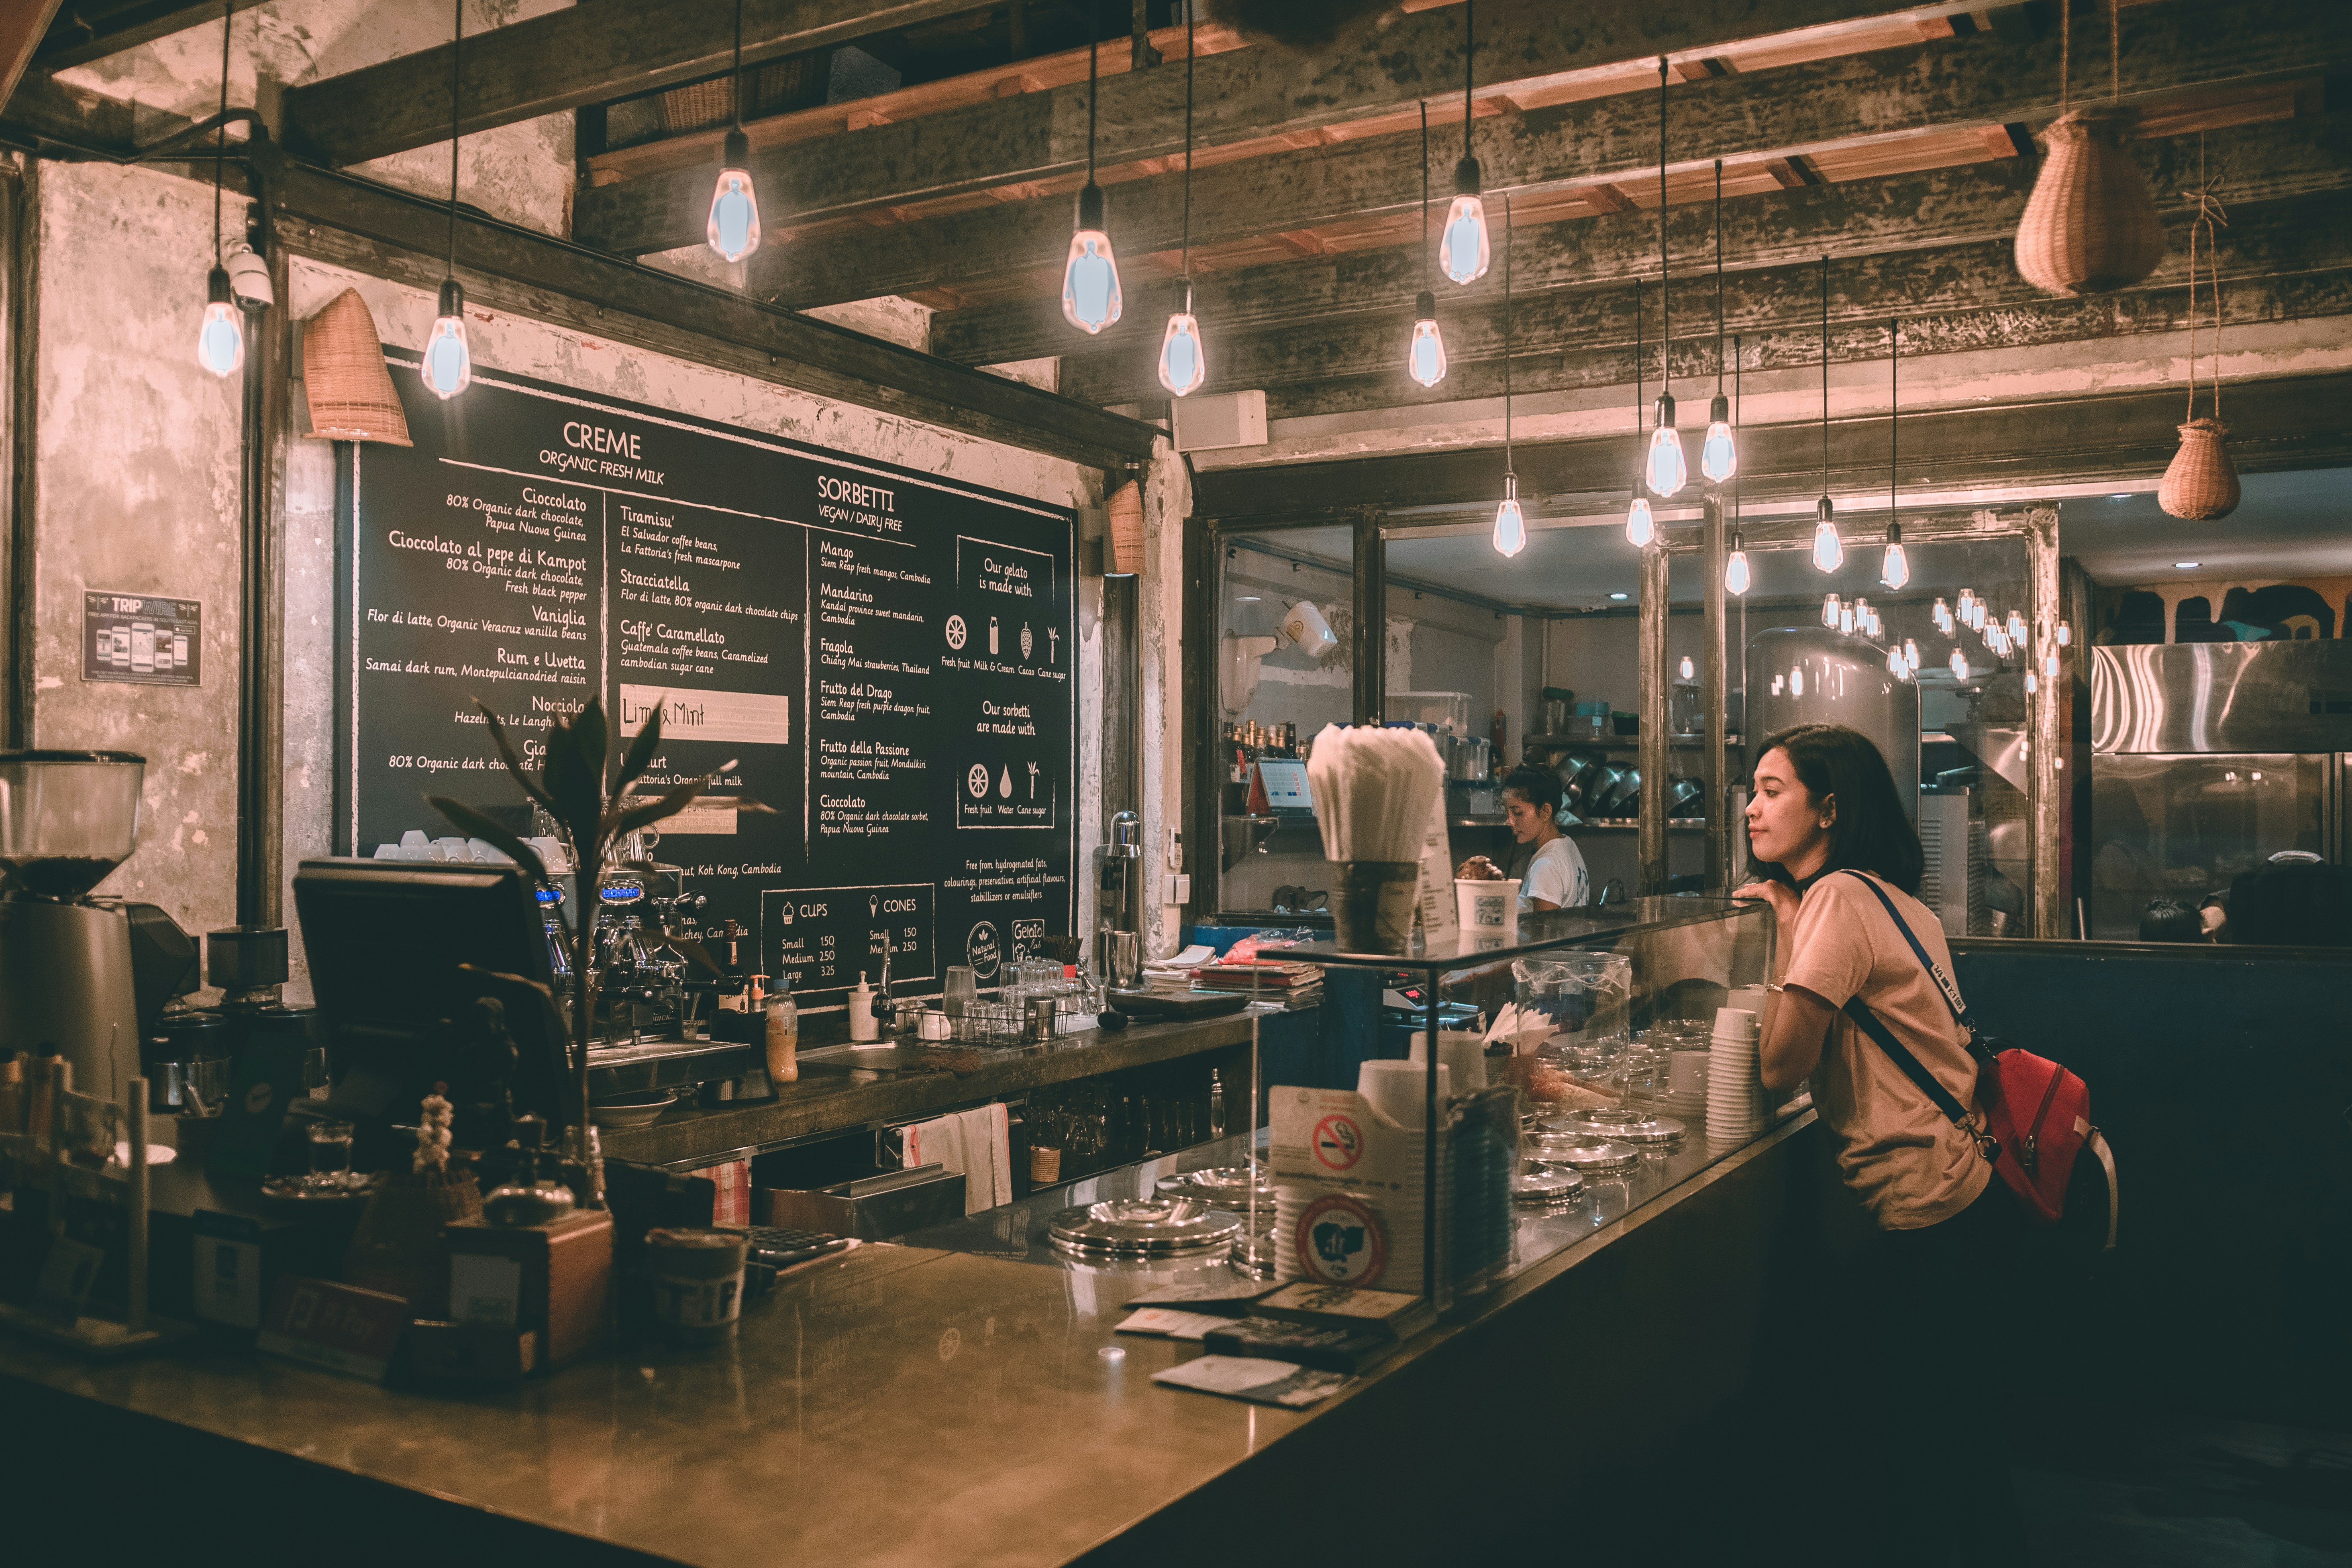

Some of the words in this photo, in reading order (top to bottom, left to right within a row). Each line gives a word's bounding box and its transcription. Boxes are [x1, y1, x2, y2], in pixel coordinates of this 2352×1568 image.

[564, 422, 641, 460] CREME
[540, 450, 597, 472] ORGANIC
[600, 461, 633, 479] FRESH
[636, 468, 664, 485] MILK
[523, 487, 586, 511] Cioccolato
[818, 476, 894, 512] SORBETTI
[447, 494, 469, 508] 80%
[473, 498, 512, 516] Organic
[516, 506, 537, 519] dark
[541, 510, 583, 527] chocolate,
[620, 506, 674, 528] Tiramisu'
[819, 504, 848, 523] VEGAN
[856, 512, 883, 532] DAIRY
[885, 518, 902, 531] FREE
[486, 516, 515, 533] Papua
[519, 521, 549, 536] Nuova
[554, 526, 586, 542] Guinea
[622, 526, 629, 536] El
[633, 528, 669, 542] Salvador
[672, 535, 692, 549] coffee
[695, 537, 717, 551] beans,
[389, 530, 461, 554] Cioccolato
[468, 541, 481, 557] al
[488, 548, 513, 567] pepe
[519, 548, 532, 563] di
[538, 550, 586, 575] Kampot
[621, 542, 631, 553] La
[635, 544, 671, 559] Fattoria's
[674, 550, 692, 564] fresh
[696, 557, 740, 571] mascarpone
[821, 541, 853, 563] Mango
[821, 557, 836, 568] Siem
[839, 560, 855, 575] Reap
[857, 563, 871, 575] fresh
[873, 569, 898, 581] mangos,
[900, 571, 930, 584] Cambodia
[985, 558, 1002, 573] Our
[1004, 563, 1028, 579] gelato
[621, 569, 689, 591] Stracciatella
[979, 575, 986, 589] is
[989, 579, 1012, 594] made
[1015, 582, 1032, 597] with
[506, 581, 528, 593] Fresh
[532, 583, 556, 597] black
[560, 591, 587, 604] pepper
[821, 583, 873, 602] Mandarino
[621, 589, 637, 600] Flor
[640, 591, 648, 602] di
[652, 592, 671, 606] latte,
[675, 595, 692, 607] 80%
[695, 601, 722, 613] organic
[725, 602, 742, 613] dark
[745, 605, 778, 618] chocolate
[781, 609, 798, 624] chips
[821, 599, 846, 611] Kandal
[848, 605, 873, 616] province
[875, 610, 890, 618] sweet
[893, 612, 924, 623] mandarin,
[368, 609, 389, 622] Flor
[392, 611, 403, 624] di
[408, 612, 432, 627] latte,
[437, 616, 478, 633] Organic
[482, 620, 521, 634] Veracruz
[525, 626, 557, 637] vanilla
[562, 629, 586, 640] beans
[532, 606, 586, 630] Vaniglia
[621, 620, 652, 642] Caffe'
[657, 624, 724, 644] Caramellato
[498, 648, 528, 665] Rum
[534, 656, 539, 666] e
[545, 652, 586, 669] Uvetta
[621, 639, 669, 655] Guatemala
[672, 645, 692, 660] coffee
[696, 646, 718, 660] beans,
[722, 650, 768, 663] Caramelized
[821, 638, 853, 658] Fragola
[366, 658, 401, 671] Samai
[406, 661, 430, 673] dark
[434, 667, 457, 676] rum,
[561, 673, 586, 684] raisin
[621, 657, 667, 669] cambodian
[671, 663, 693, 675] sugar
[821, 654, 846, 669] Chiang
[848, 657, 862, 667] Mai
[865, 661, 899, 672] strawberries,
[902, 663, 929, 674] Thailand
[942, 656, 956, 667] Fresh
[958, 658, 970, 671] fruit
[974, 660, 988, 670] Milk
[990, 662, 995, 671] &
[997, 663, 1014, 673] Cream
[1018, 665, 1034, 675] Cacao
[1038, 668, 1051, 677] Cane
[1053, 672, 1066, 682] sugar
[821, 680, 847, 695] Frutto
[851, 683, 863, 696] del
[867, 685, 892, 703] Drago
[662, 708, 671, 725] &
[674, 702, 704, 726] Mint
[983, 701, 1000, 715] Our
[1004, 703, 1030, 718] sorbetti
[977, 723, 989, 732] are
[993, 720, 1015, 734] made
[1018, 722, 1036, 735] with
[821, 739, 847, 752] Frutto
[851, 740, 872, 754] della
[876, 742, 909, 755] Passione
[821, 756, 847, 769] Organic
[849, 757, 872, 769] passion
[875, 758, 889, 770] fruit,
[891, 759, 926, 769] Mondulkiri
[820, 795, 865, 807] Cioccolato
[967, 860, 977, 869] Free
[979, 860, 993, 873] from
[995, 858, 1034, 873] hydrogenated
[1036, 858, 1046, 871] fats,
[944, 877, 977, 890] colourings,
[979, 877, 1014, 889] preservatives,
[1017, 874, 1041, 887] artificial
[1043, 873, 1065, 886] flavours,
[800, 903, 827, 917] CUPS
[884, 899, 916, 912] CONES
[870, 929, 889, 940] Small
[904, 927, 917, 938] 1.50
[1014, 923, 1042, 940] Gelato
[782, 938, 804, 949] Small
[821, 936, 834, 946] 1.50
[902, 941, 917, 952] 2.50
[972, 939, 995, 956] Natural
[1030, 939, 1041, 950] lab
[783, 953, 814, 964] Medium
[820, 950, 835, 961] 2.50
[984, 950, 997, 962] Food
[783, 970, 802, 983] Large
[821, 965, 834, 976] 3.25
